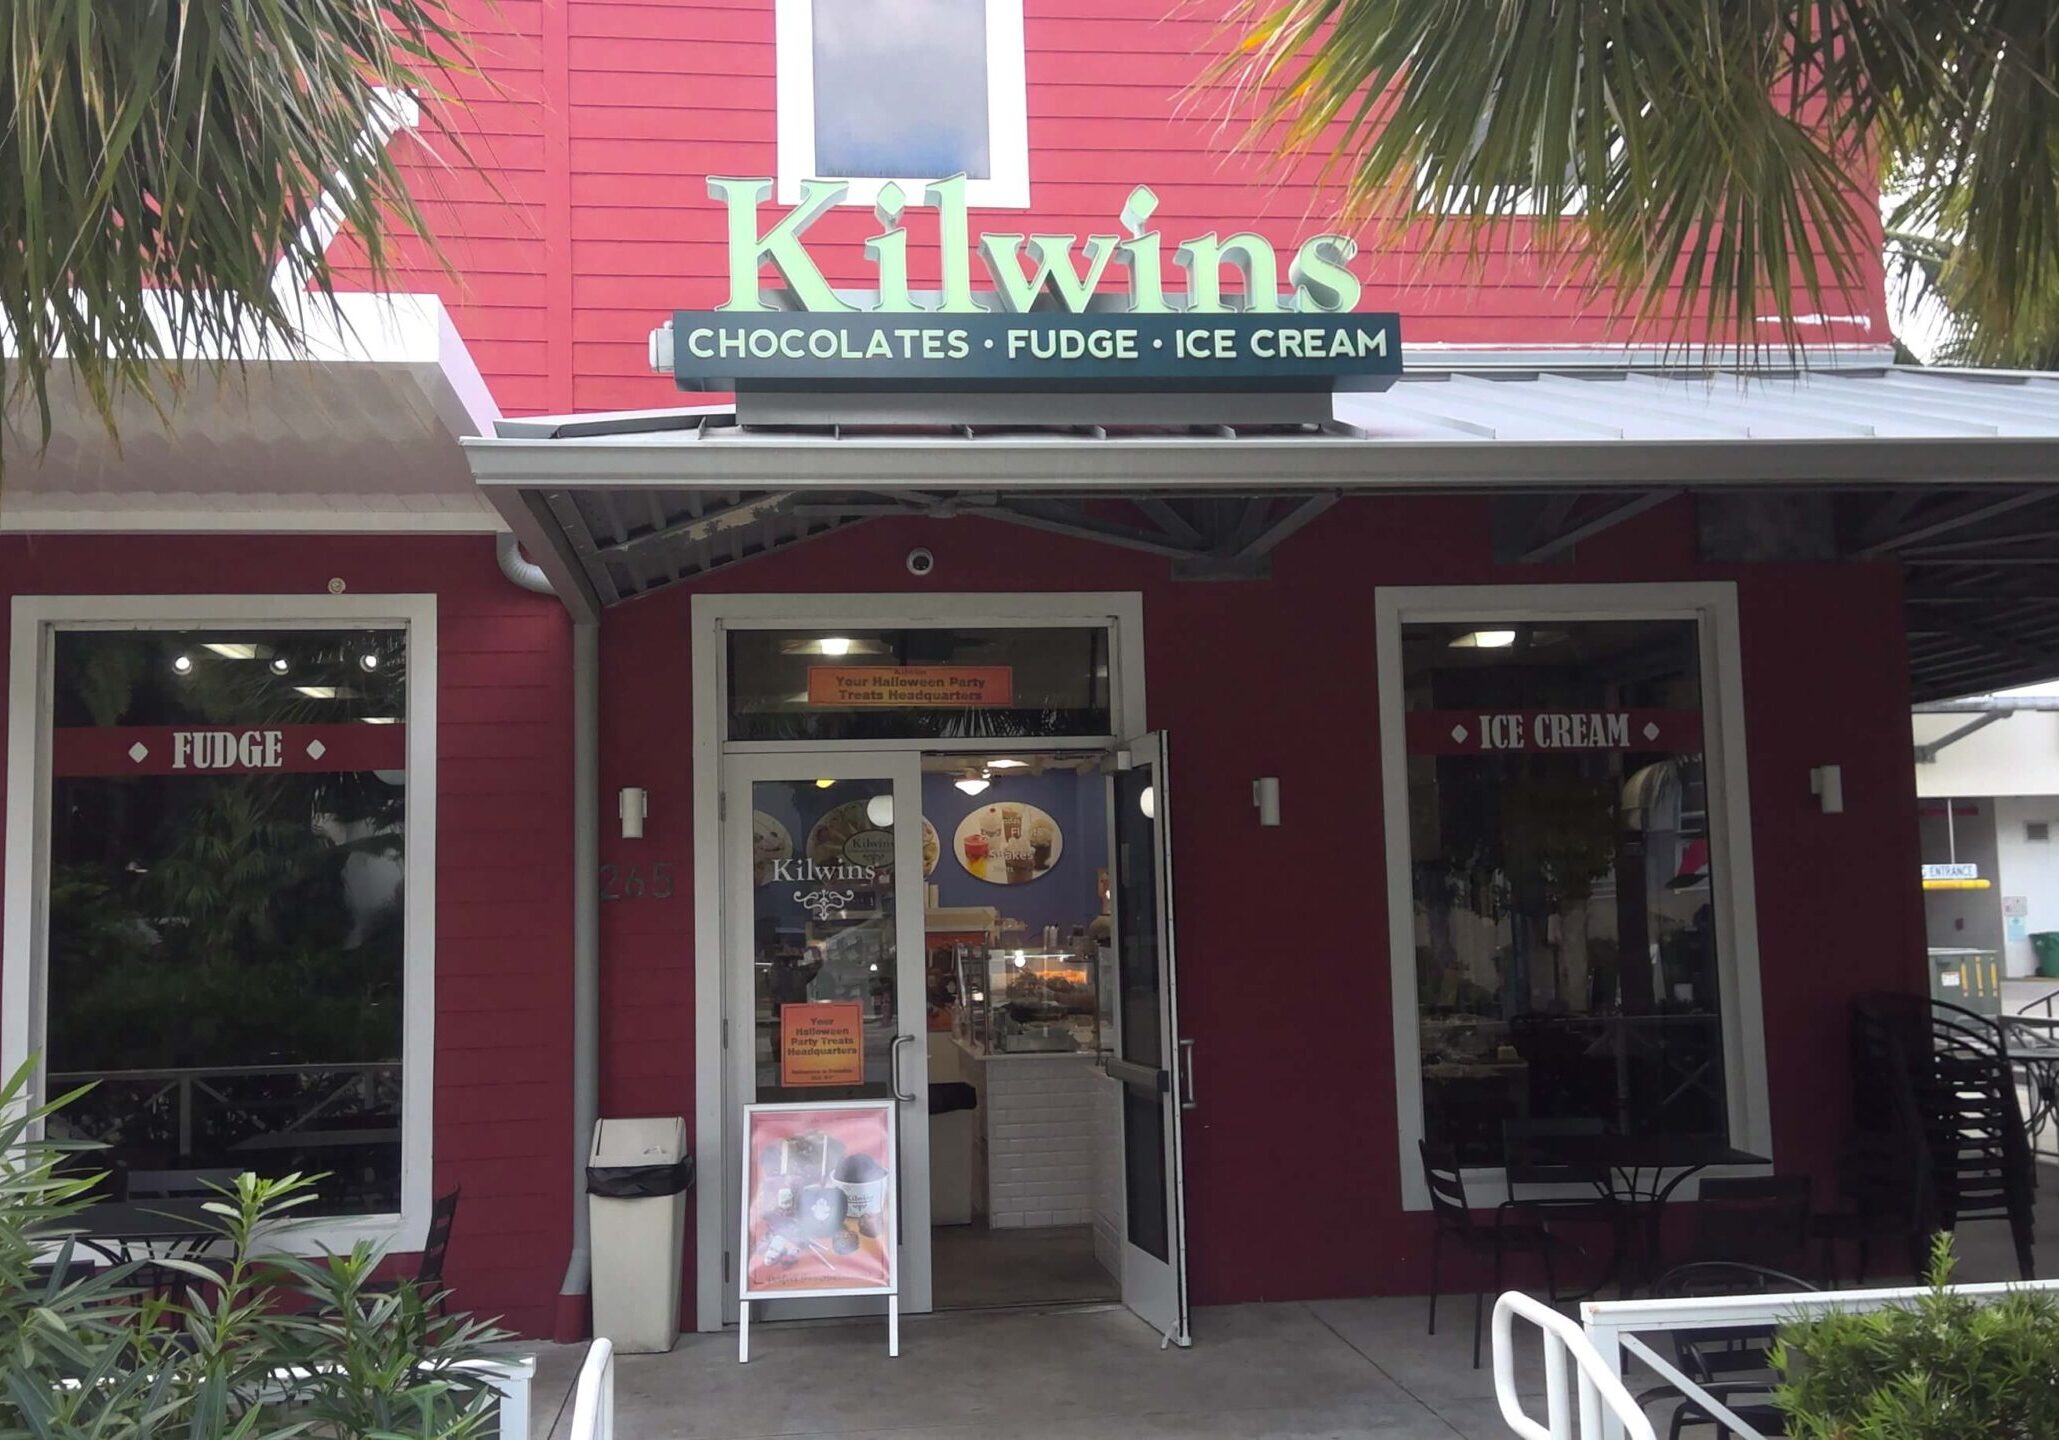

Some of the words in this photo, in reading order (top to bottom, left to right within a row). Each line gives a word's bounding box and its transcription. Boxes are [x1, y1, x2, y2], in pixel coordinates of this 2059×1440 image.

[706, 172, 1362, 313] Kilwins
[688, 328, 970, 360] CHOCOLATES
[1007, 328, 1140, 360] FUDGE
[1175, 328, 1238, 360] ICE
[1250, 328, 1388, 360] CREAM
[835, 675, 868, 688] Your
[872, 675, 945, 688] Halloween
[949, 676, 986, 690] Party
[838, 689, 884, 700] Treats
[888, 689, 983, 703] Headquarters
[1479, 715, 1525, 750] ICE
[1533, 713, 1631, 749] CREAM
[172, 730, 283, 769] FUDGE
[1930, 865, 1974, 877] ENTRANCE
[599, 862, 675, 900] 265
[810, 1017, 834, 1026] Your
[796, 1027, 850, 1036] Halloween
[791, 1037, 818, 1047] Party
[820, 1036, 854, 1045] Treats
[787, 1046, 858, 1057] Headquarters
